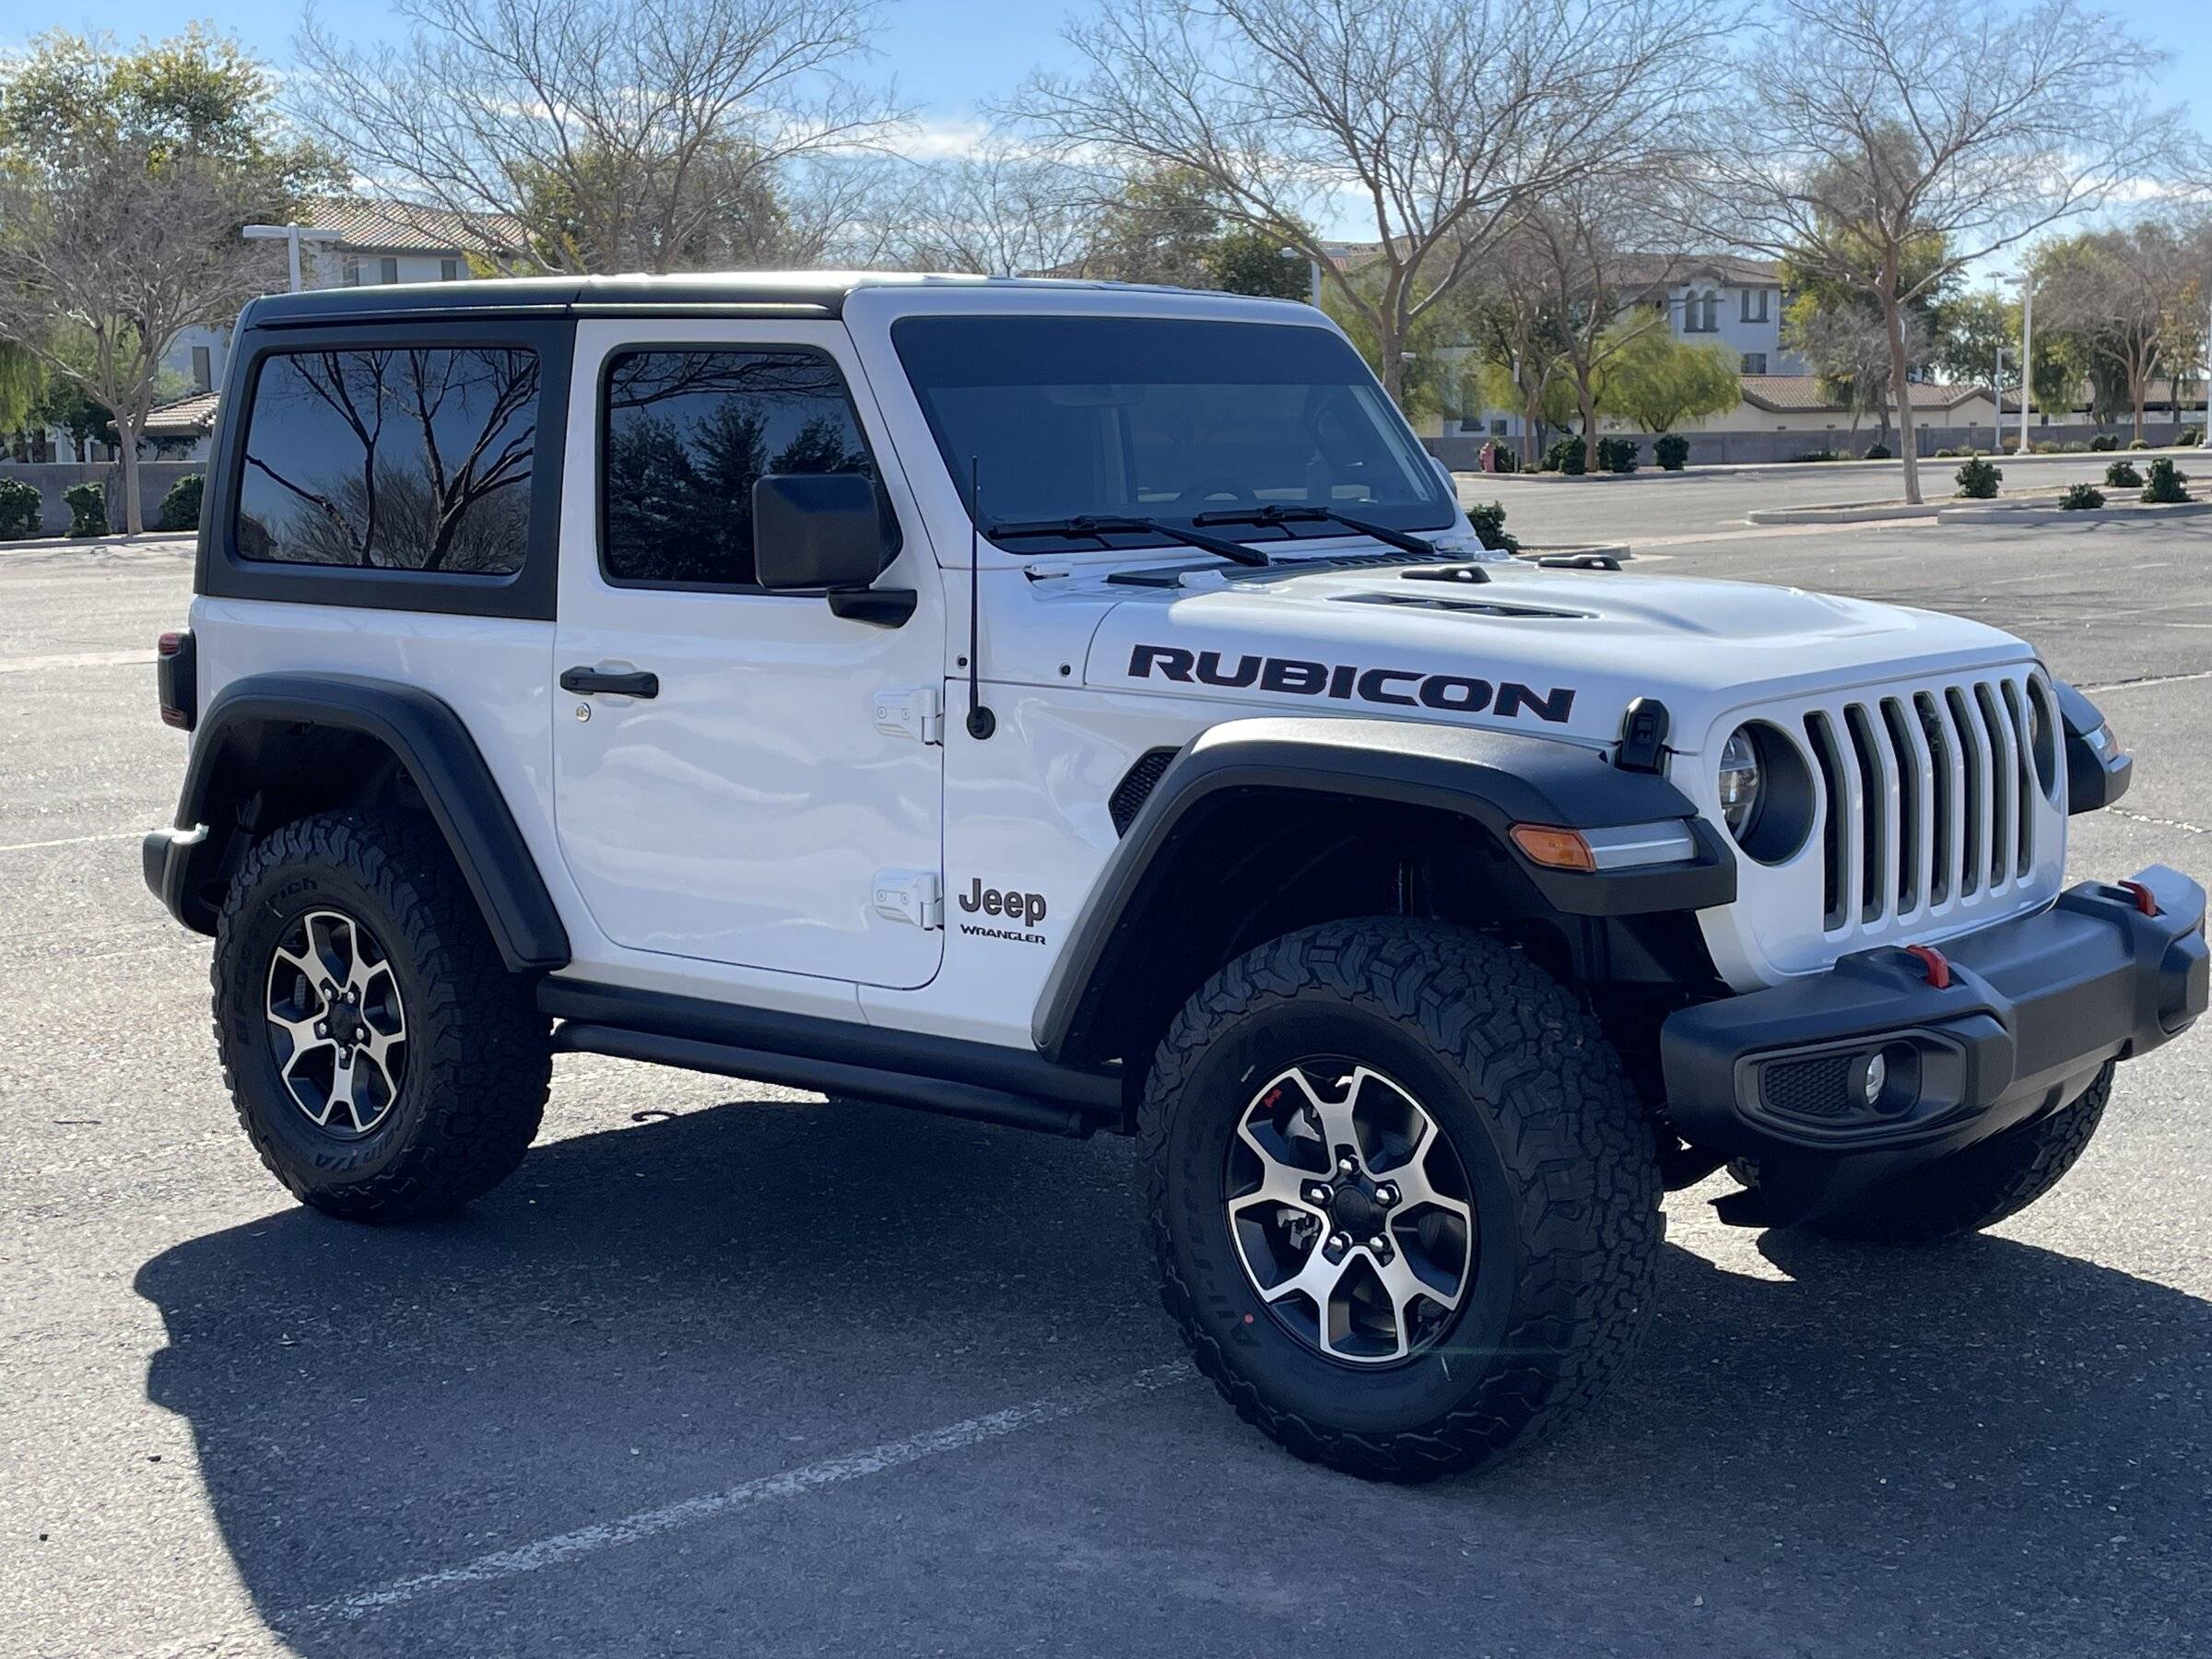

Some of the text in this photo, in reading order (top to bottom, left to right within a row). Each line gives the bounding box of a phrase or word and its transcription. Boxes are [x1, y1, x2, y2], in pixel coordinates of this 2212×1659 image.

[1127, 643, 1576, 724] RUBICON
[958, 877, 1046, 928] Jeep
[959, 924, 1047, 946] WRANGLER
